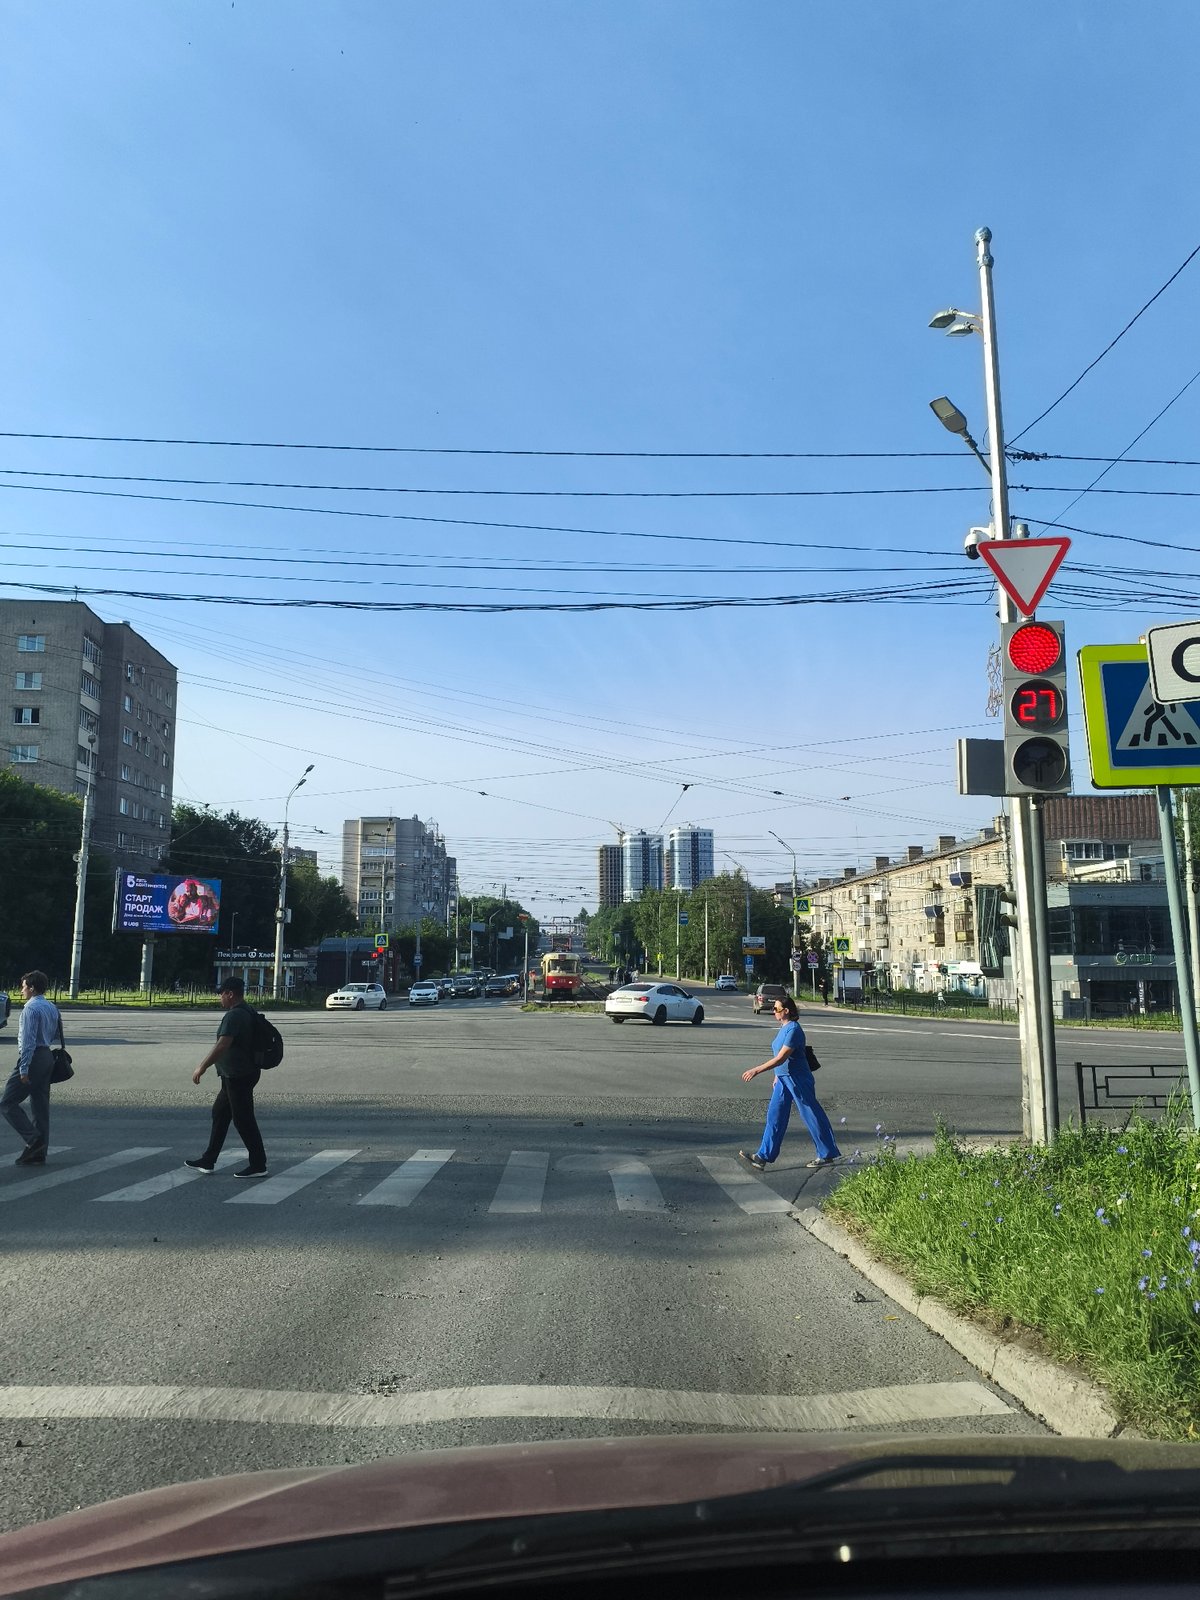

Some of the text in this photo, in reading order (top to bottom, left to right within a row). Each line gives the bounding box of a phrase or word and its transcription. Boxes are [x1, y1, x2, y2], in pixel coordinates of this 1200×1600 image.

[1019, 690, 1056, 720] 27
[125, 894, 152, 903] СТАРТ
[124, 903, 163, 913] ПРОДАЖ
